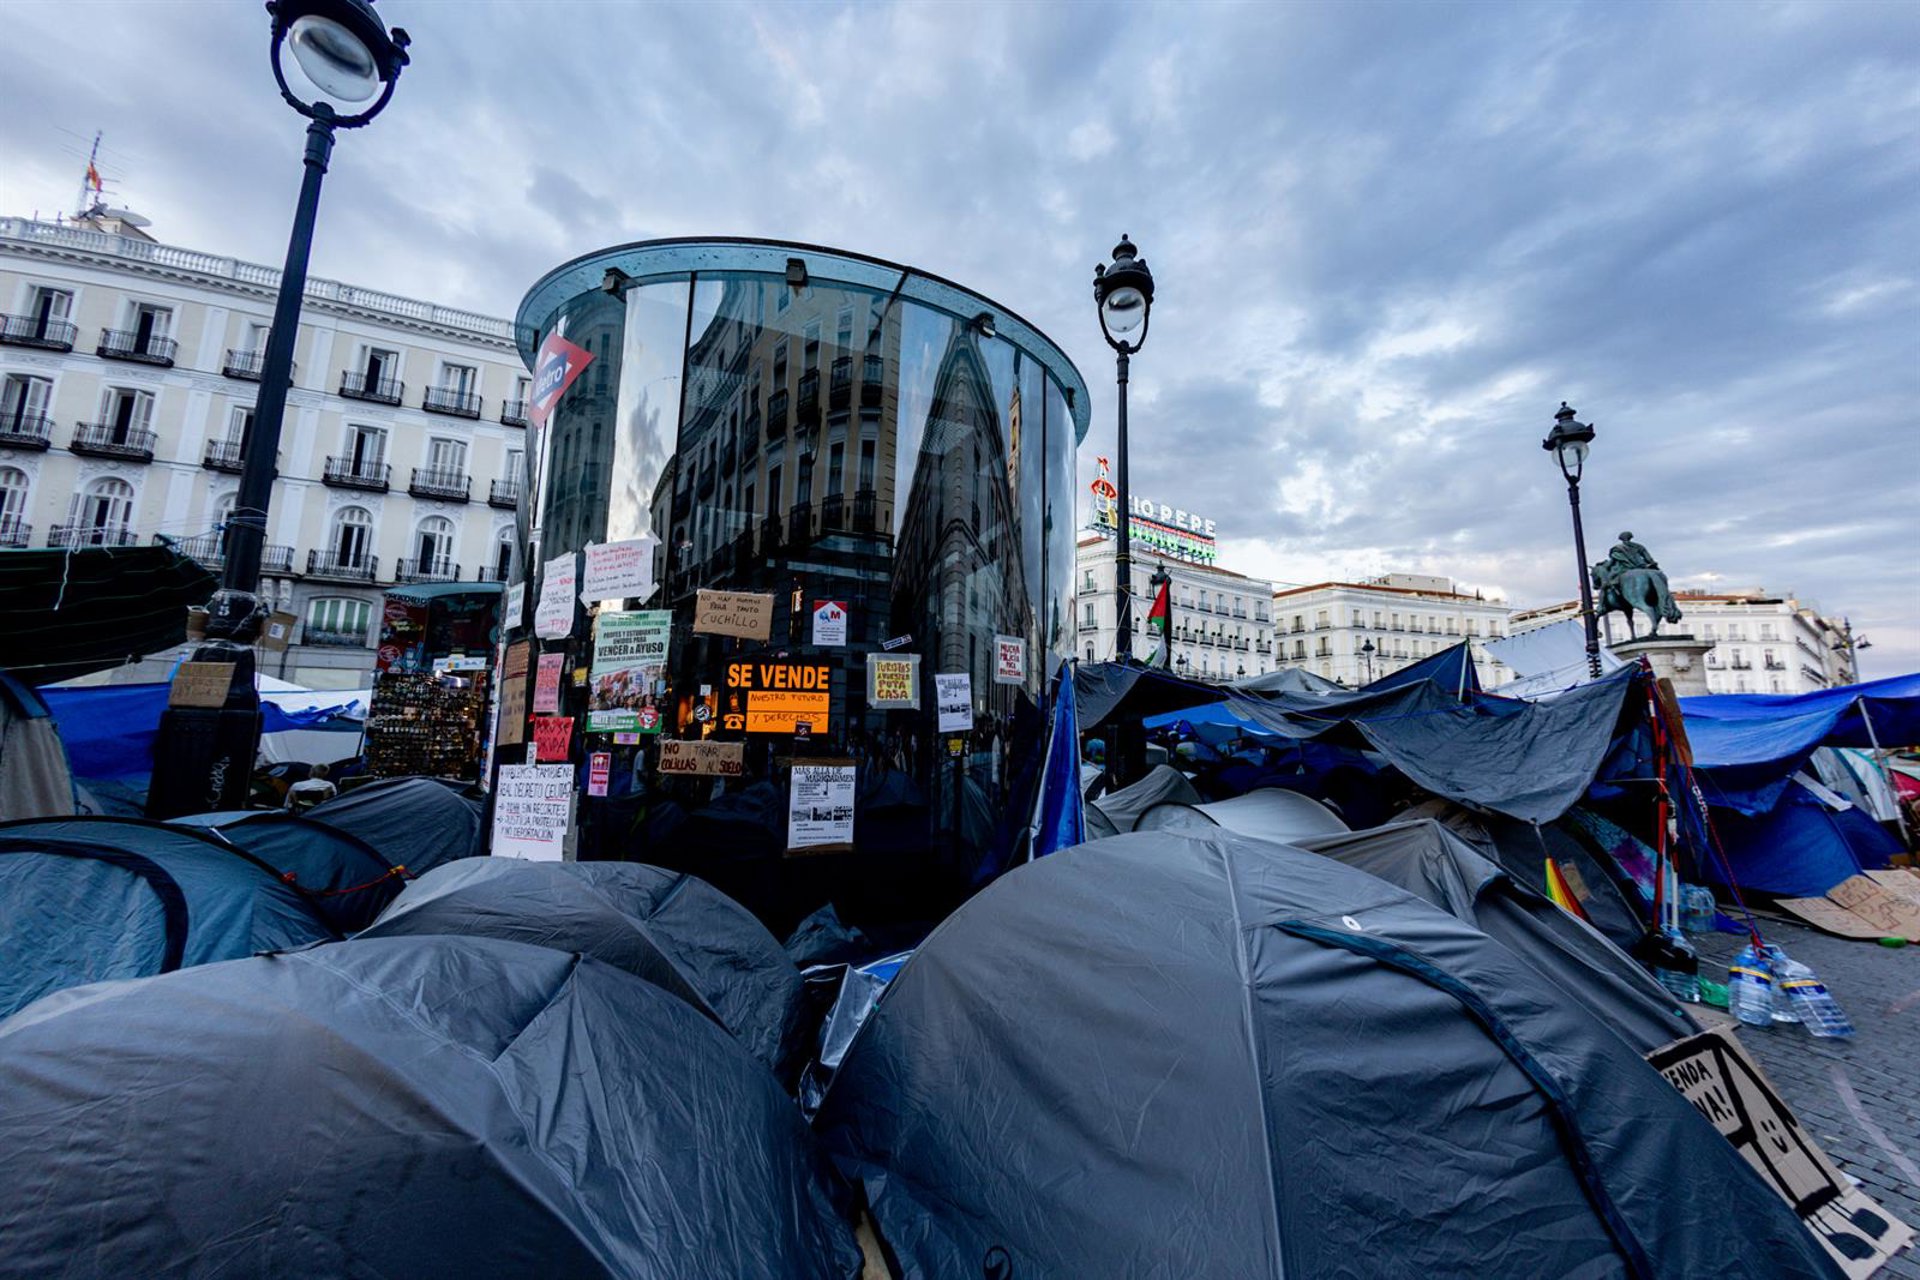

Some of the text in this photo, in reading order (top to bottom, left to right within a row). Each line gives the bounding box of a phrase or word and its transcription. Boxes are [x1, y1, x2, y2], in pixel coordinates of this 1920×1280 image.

[1128, 494, 1154, 518] IO
[1160, 504, 1217, 538] PEPE
[598, 645, 629, 656] VENCER
[635, 642, 664, 654] AYUSO
[727, 664, 829, 689] SE VENDE
[878, 680, 906, 689] PUTA
[876, 689, 909, 700] CASA
[664, 743, 680, 754] NO
